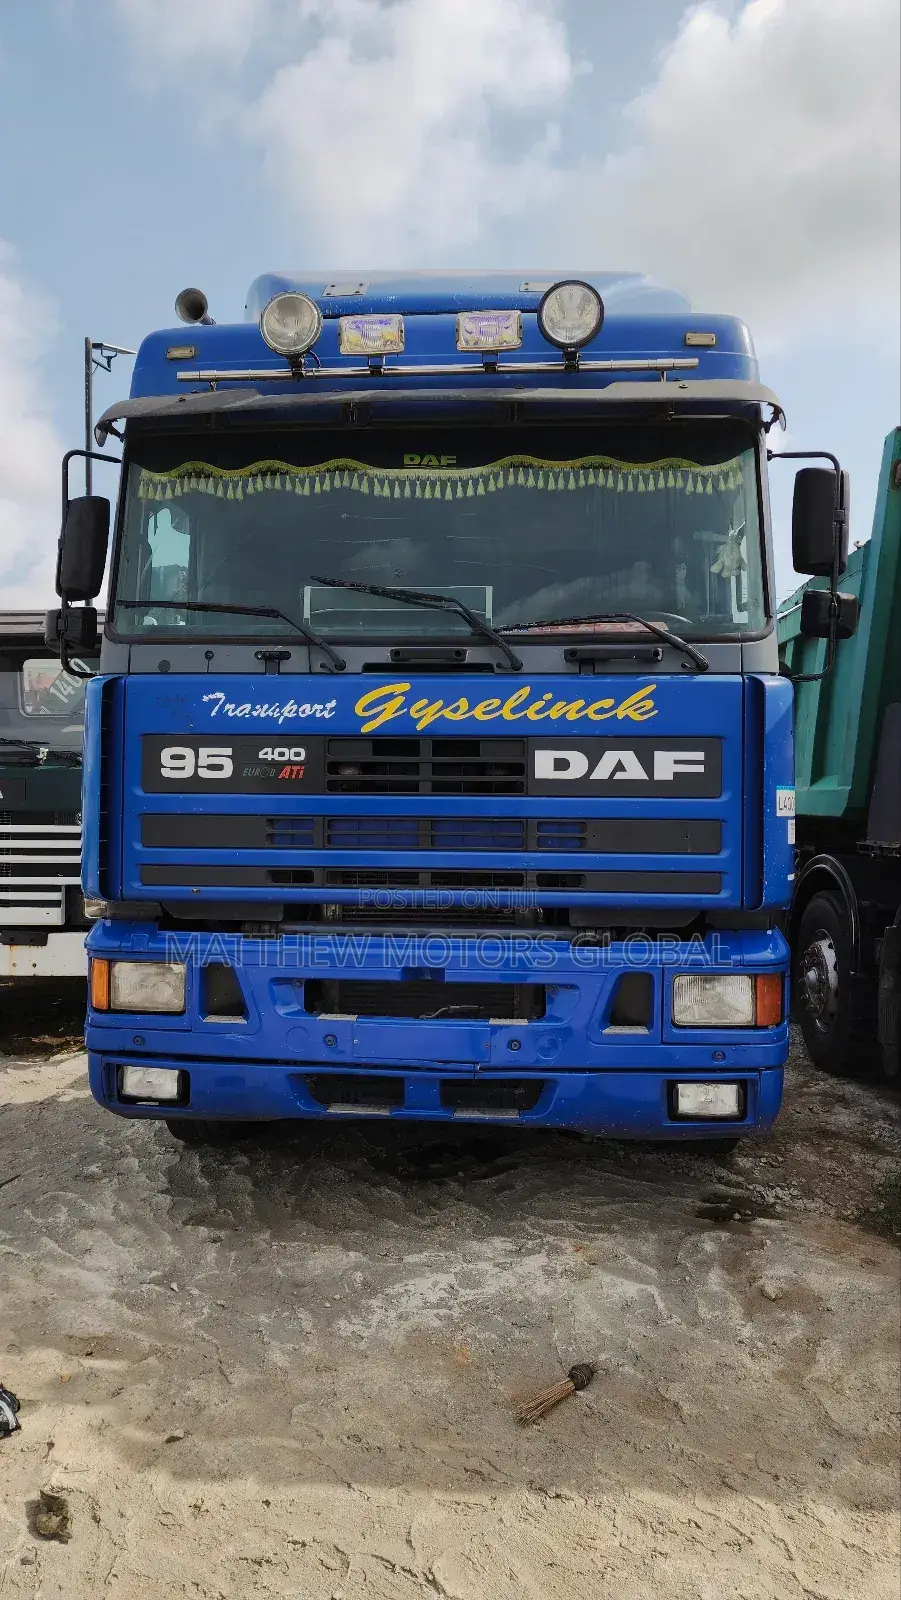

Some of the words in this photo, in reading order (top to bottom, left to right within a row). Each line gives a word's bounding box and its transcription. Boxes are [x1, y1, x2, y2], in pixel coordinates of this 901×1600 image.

[403, 453, 457, 466] DAF
[202, 691, 337, 724] Transport
[354, 682, 658, 733] Gyselinck
[160, 746, 234, 779] 95
[258, 747, 306, 762] 400
[534, 750, 706, 781] DAF
